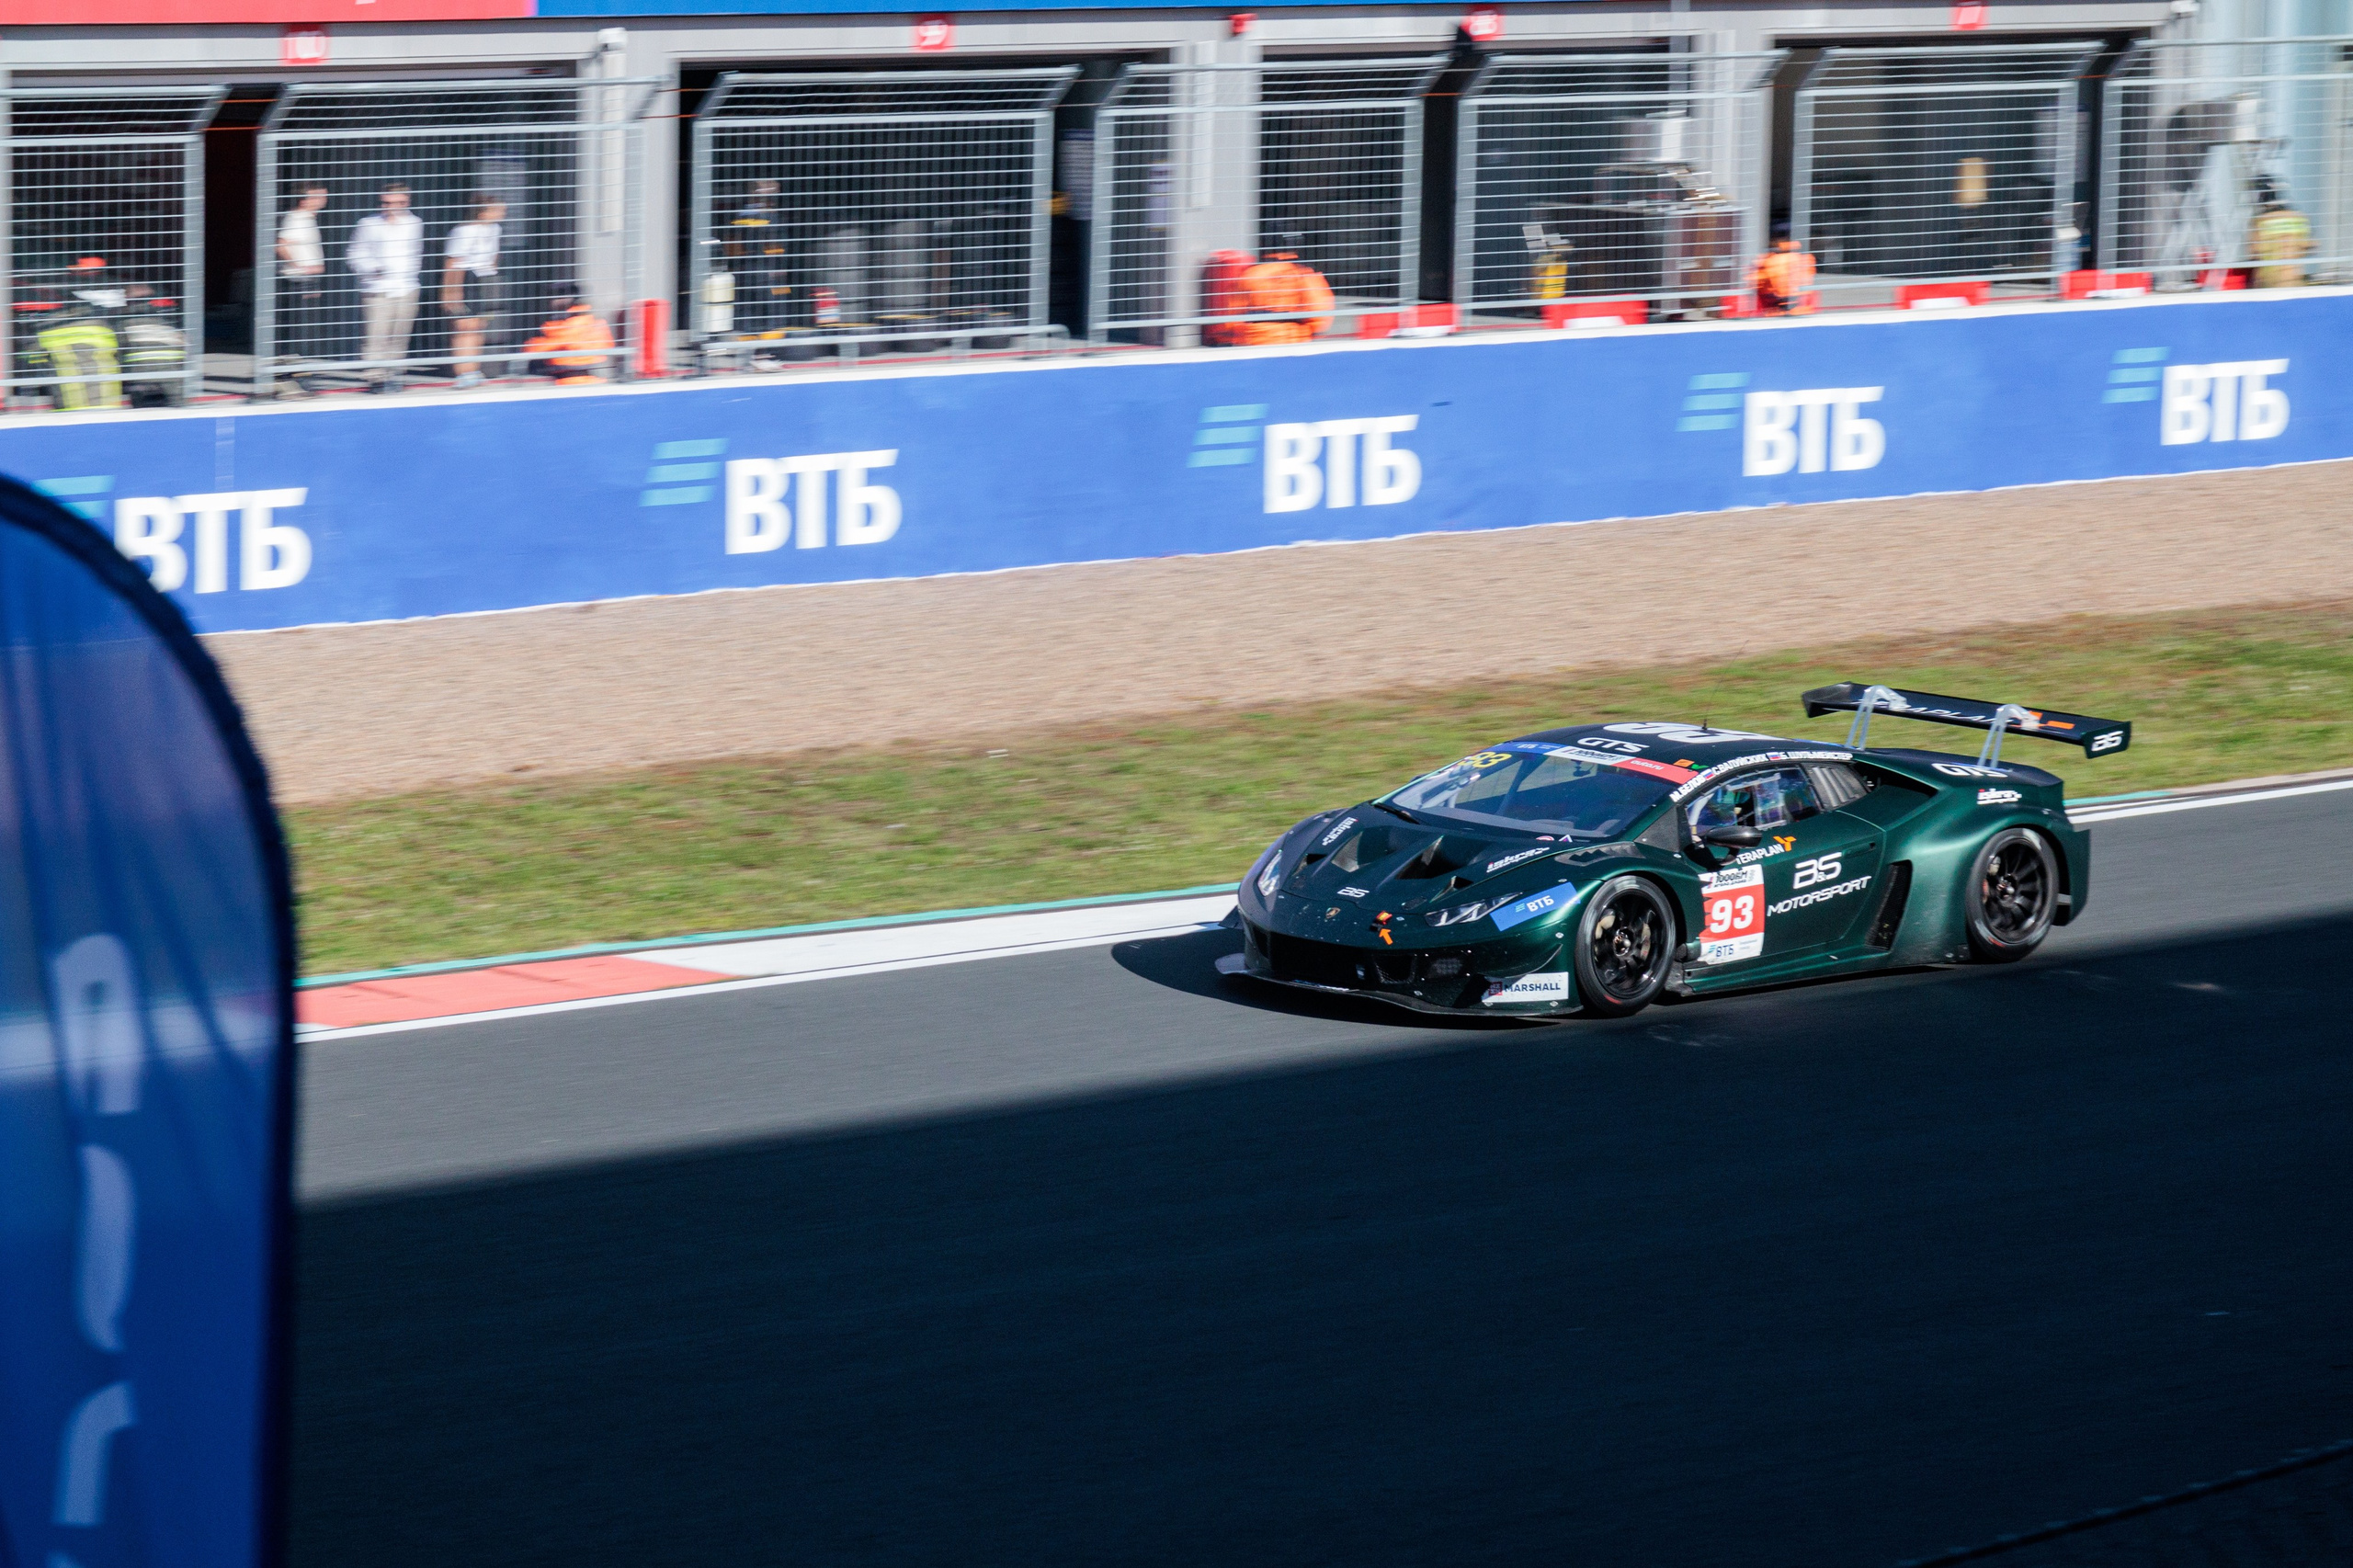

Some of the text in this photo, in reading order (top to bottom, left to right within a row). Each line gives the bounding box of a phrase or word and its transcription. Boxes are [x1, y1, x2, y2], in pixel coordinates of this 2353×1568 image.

[2161, 358, 2290, 446] ВТБ
[1743, 386, 1886, 476] ВТБ
[1263, 415, 1422, 514] ВТБ
[724, 449, 903, 555] ВТБ
[114, 487, 313, 594] ВТБ
[1577, 737, 1651, 753] GTS
[1630, 760, 1665, 770] auto.ru
[1736, 844, 1785, 865] TERAPLAN
[1526, 895, 1554, 912] ВТБ
[1710, 894, 1755, 933] 93
[1767, 876, 1872, 916] MOTORSPORT
[1715, 944, 1734, 957] ВТБ
[1504, 983, 1561, 993] MARSHALL
